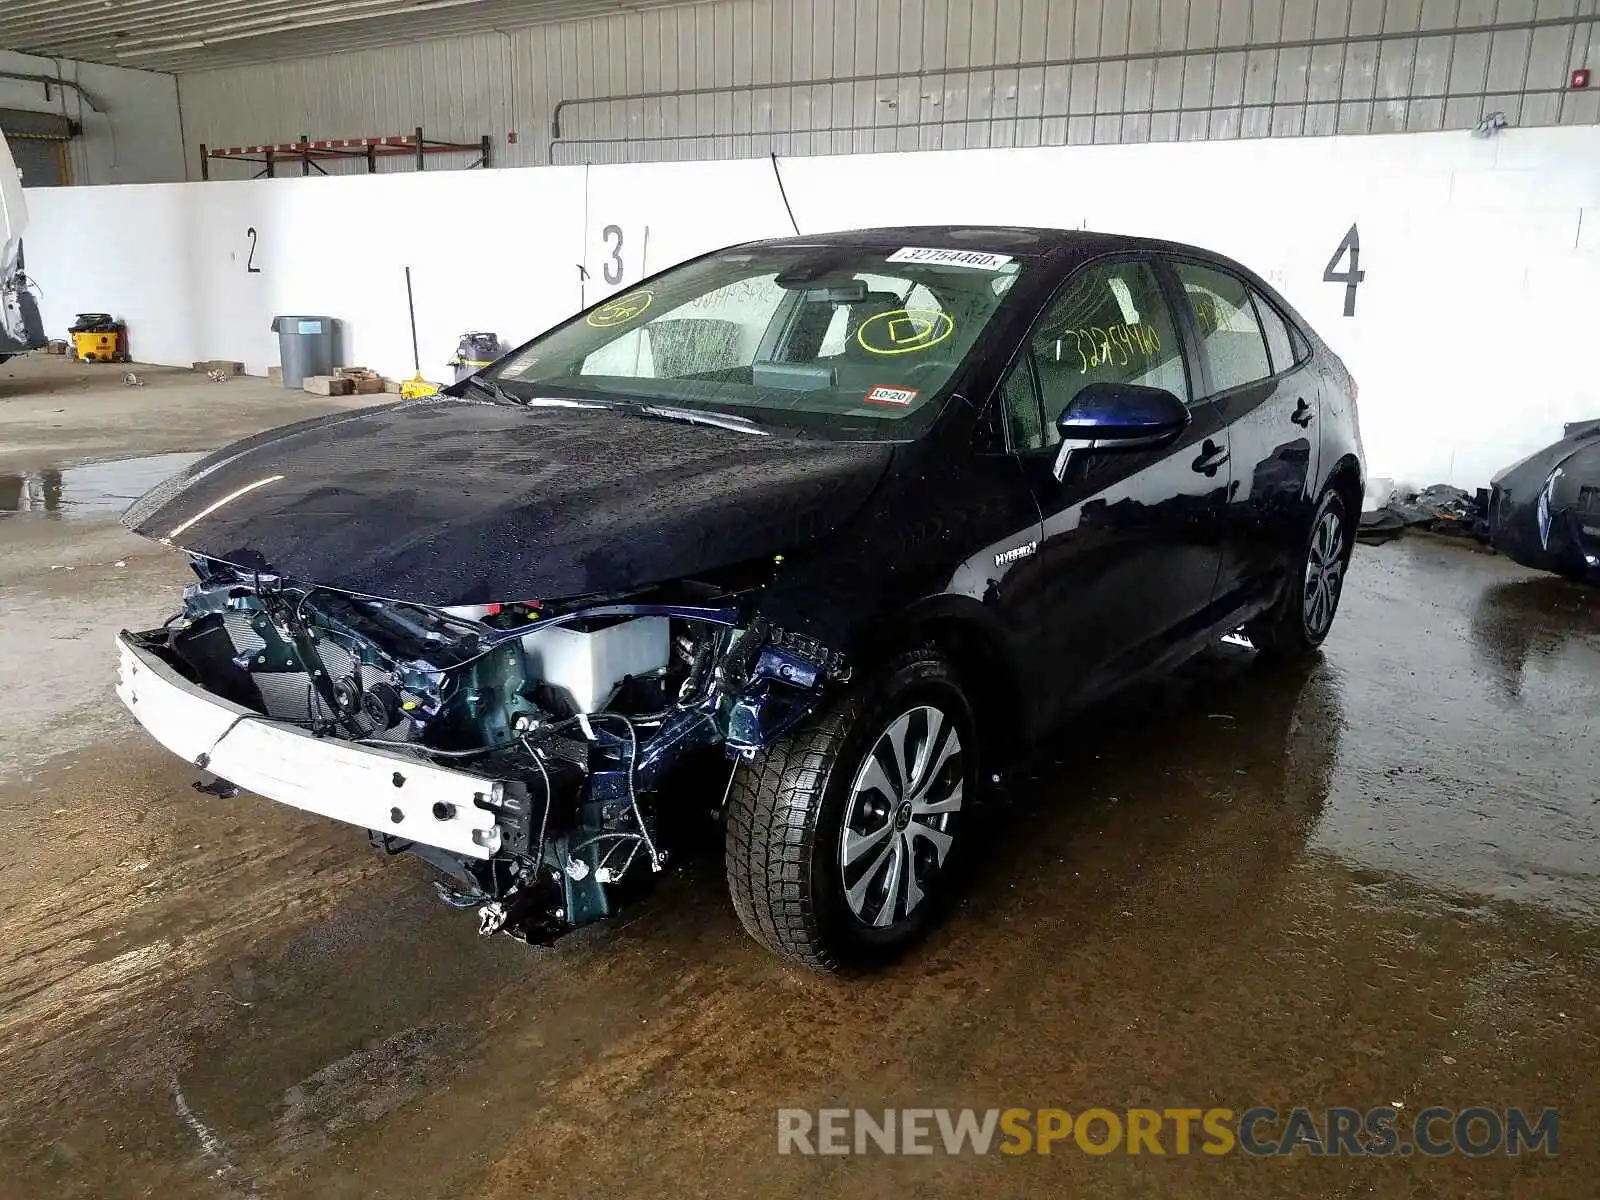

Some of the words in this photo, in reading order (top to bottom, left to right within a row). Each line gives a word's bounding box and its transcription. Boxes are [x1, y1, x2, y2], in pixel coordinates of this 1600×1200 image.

[247, 227, 261, 273] 2
[603, 225, 623, 285] 3
[1322, 222, 1365, 317] 4
[994, 541, 1037, 567] HYBRID
